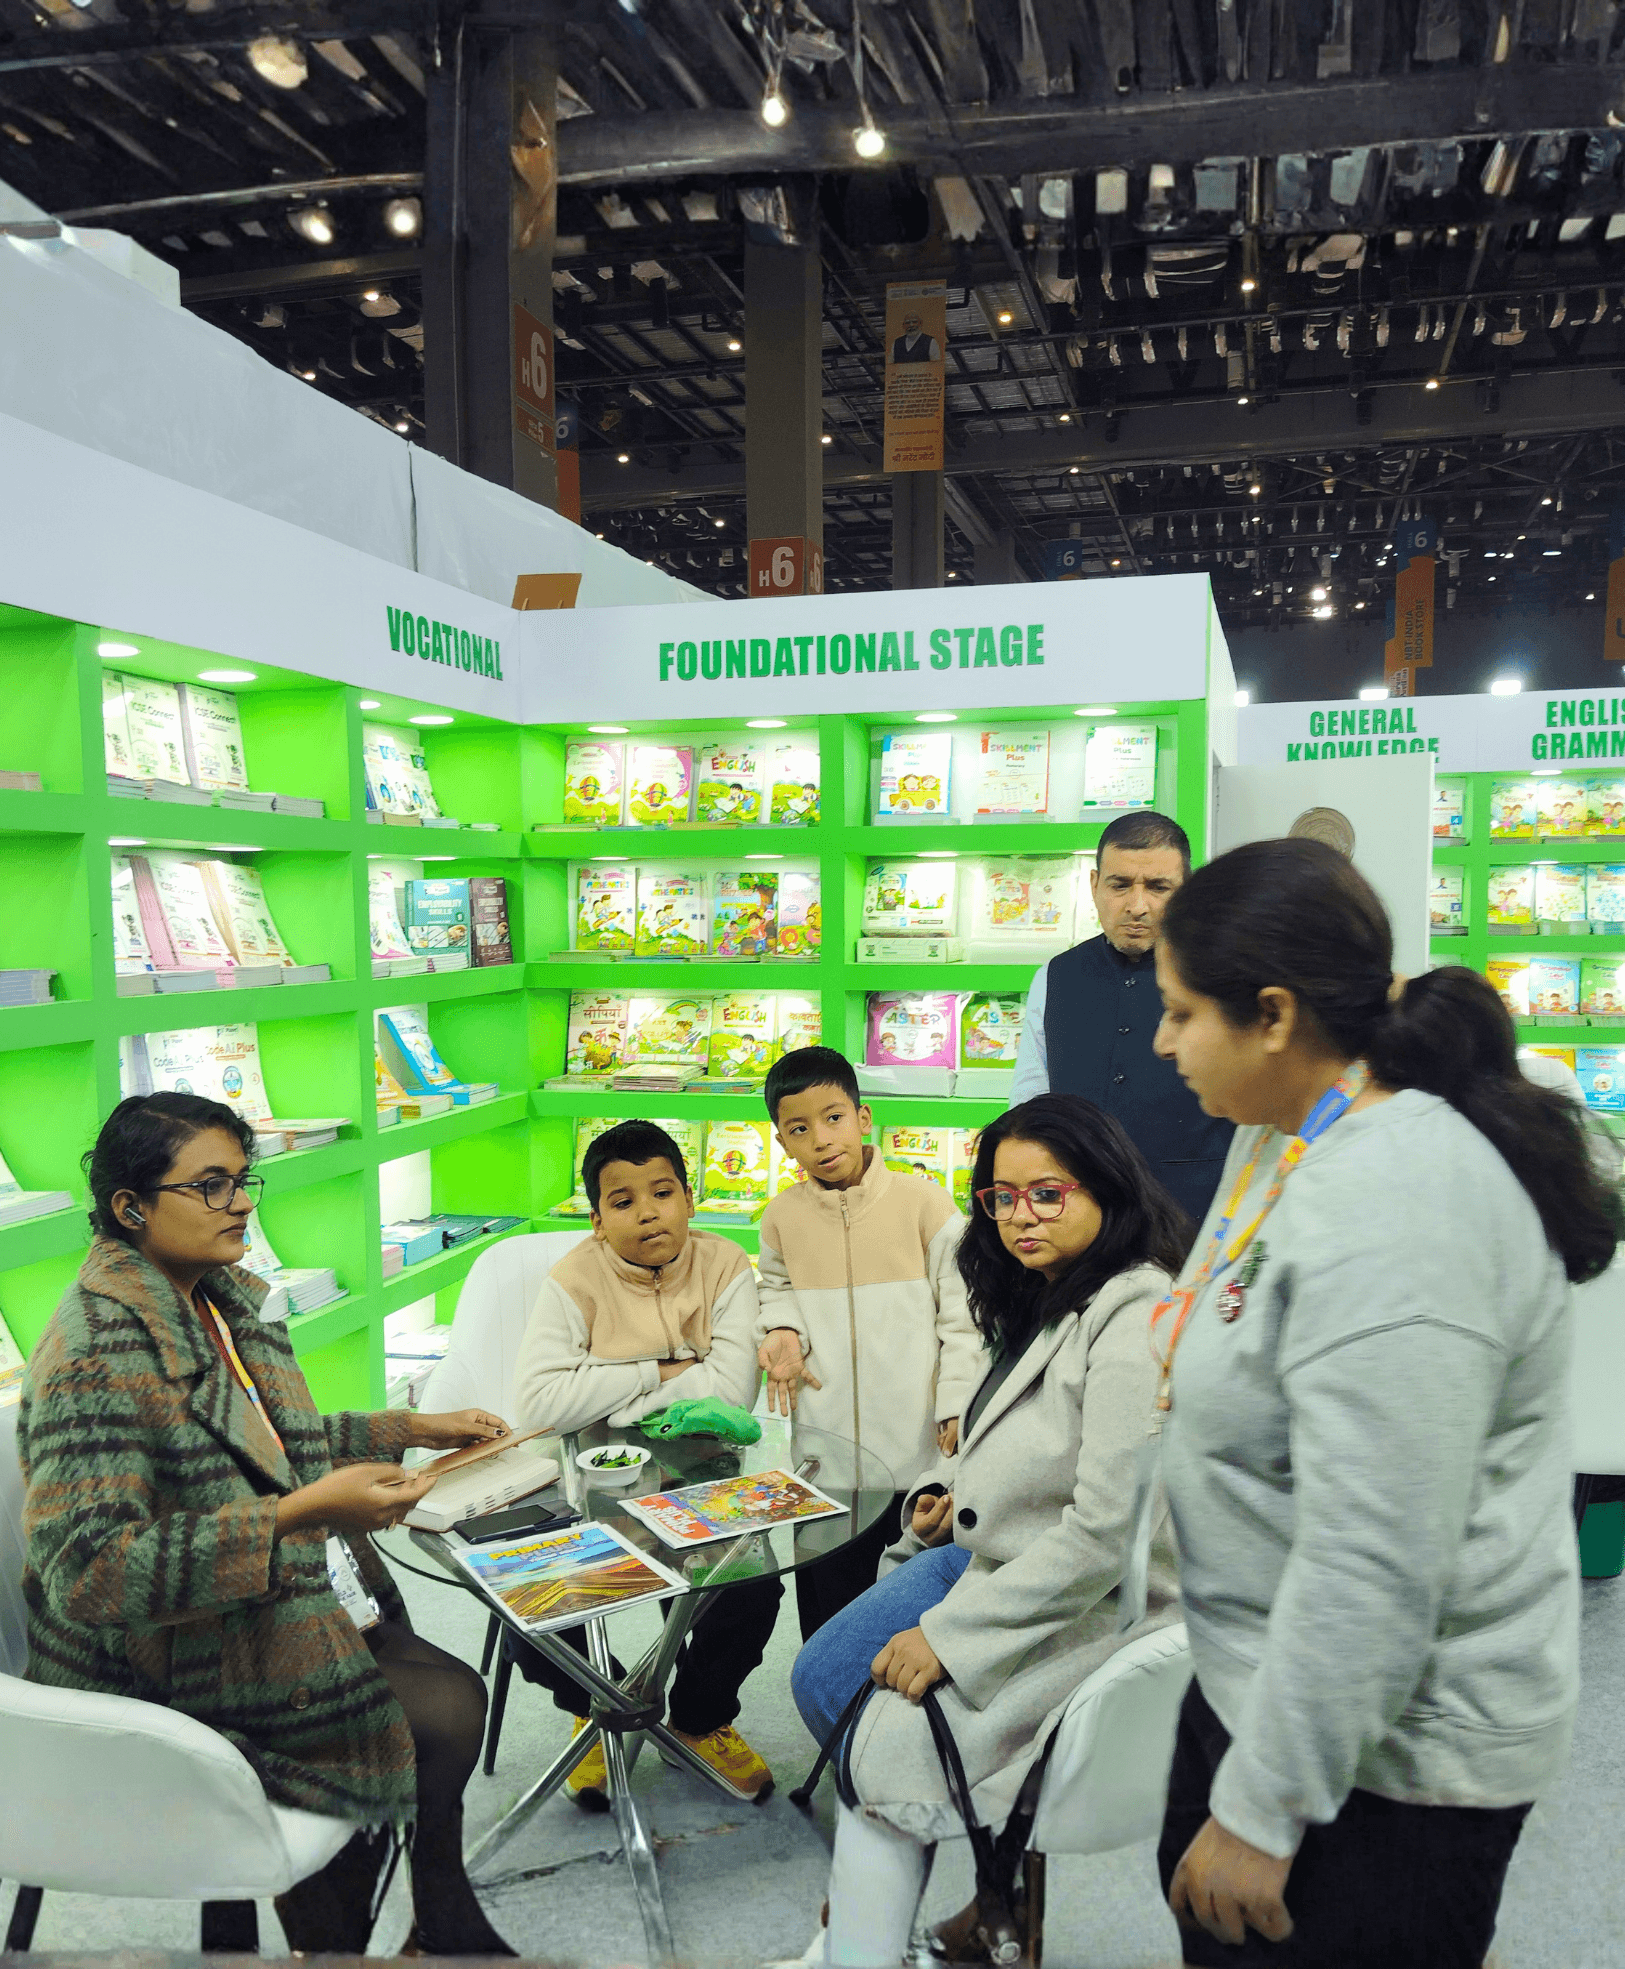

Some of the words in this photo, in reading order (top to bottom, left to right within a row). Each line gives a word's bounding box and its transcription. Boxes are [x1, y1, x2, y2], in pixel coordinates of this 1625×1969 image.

[556, 416, 569, 438] 6
[1415, 531, 1428, 548] 6
[1063, 550, 1075, 567] 6
[1405, 610, 1413, 638] INDIA
[1416, 599, 1424, 629] STORE
[386, 605, 503, 681] VOCATIONAL
[659, 632, 920, 681] FOUNDATIONAL
[929, 623, 1044, 670] STAGE
[1415, 631, 1423, 660] BOOK
[1310, 707, 1417, 737] GENERAL
[1546, 698, 1625, 728] ENGLI
[990, 744, 1043, 752] SKILLMENT
[711, 756, 756, 773] ENGLISH
[723, 1007, 767, 1023] ENGLISH
[885, 1013, 940, 1025] ASTER
[977, 1011, 1020, 1024] ASTE
[237, 1042, 256, 1053] Plus
[893, 1134, 938, 1152] ENGLISH
[642, 1504, 696, 1534] PRIMARY
[489, 1532, 582, 1560] PRIMARY
